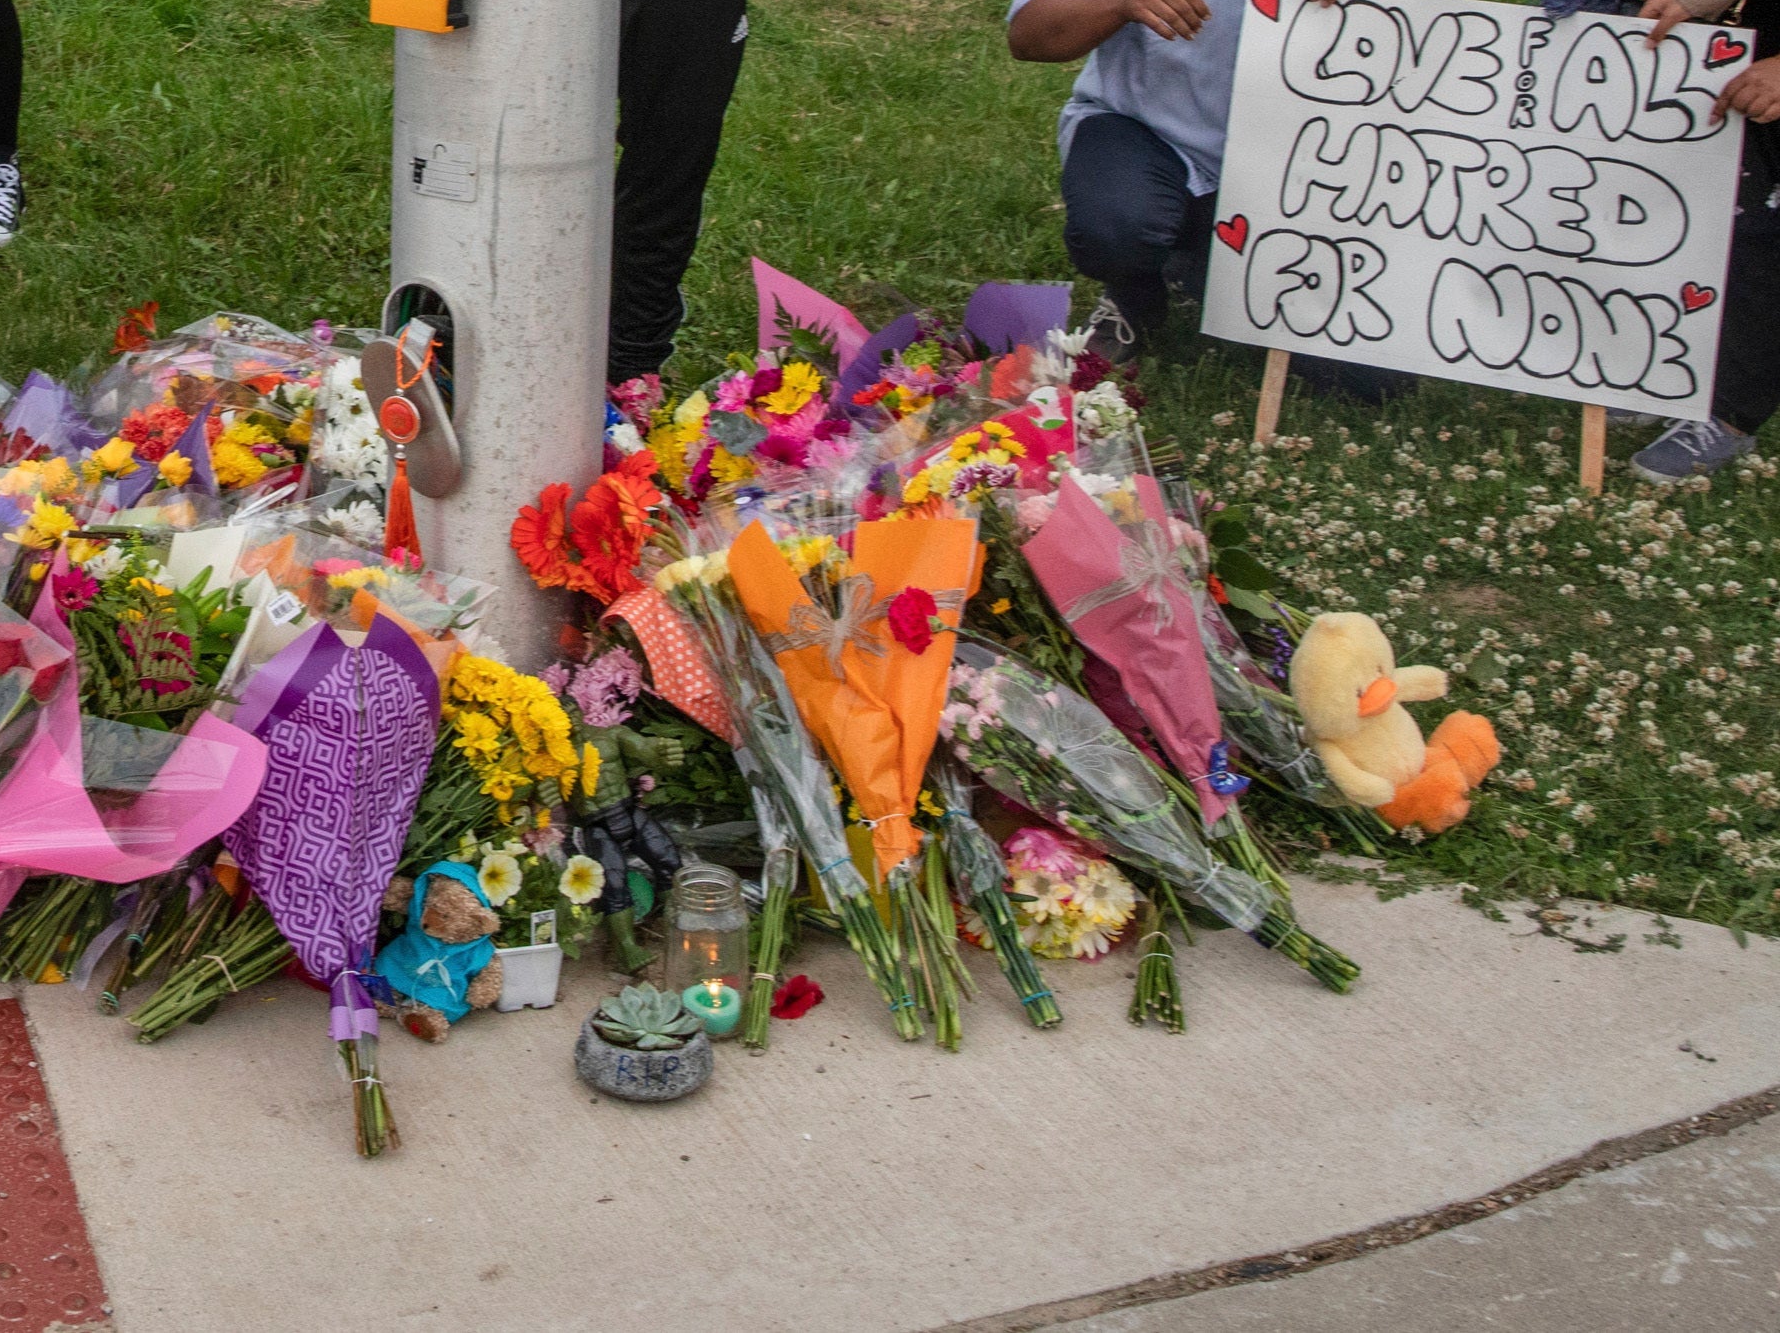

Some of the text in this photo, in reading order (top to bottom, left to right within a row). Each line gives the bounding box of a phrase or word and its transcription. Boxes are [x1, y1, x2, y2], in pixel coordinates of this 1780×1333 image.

[1510, 16, 1554, 128] FOR
[1551, 22, 1728, 143] ALL
[1280, 117, 1689, 266] HATRED
[1245, 228, 1697, 400] FOR NONE
